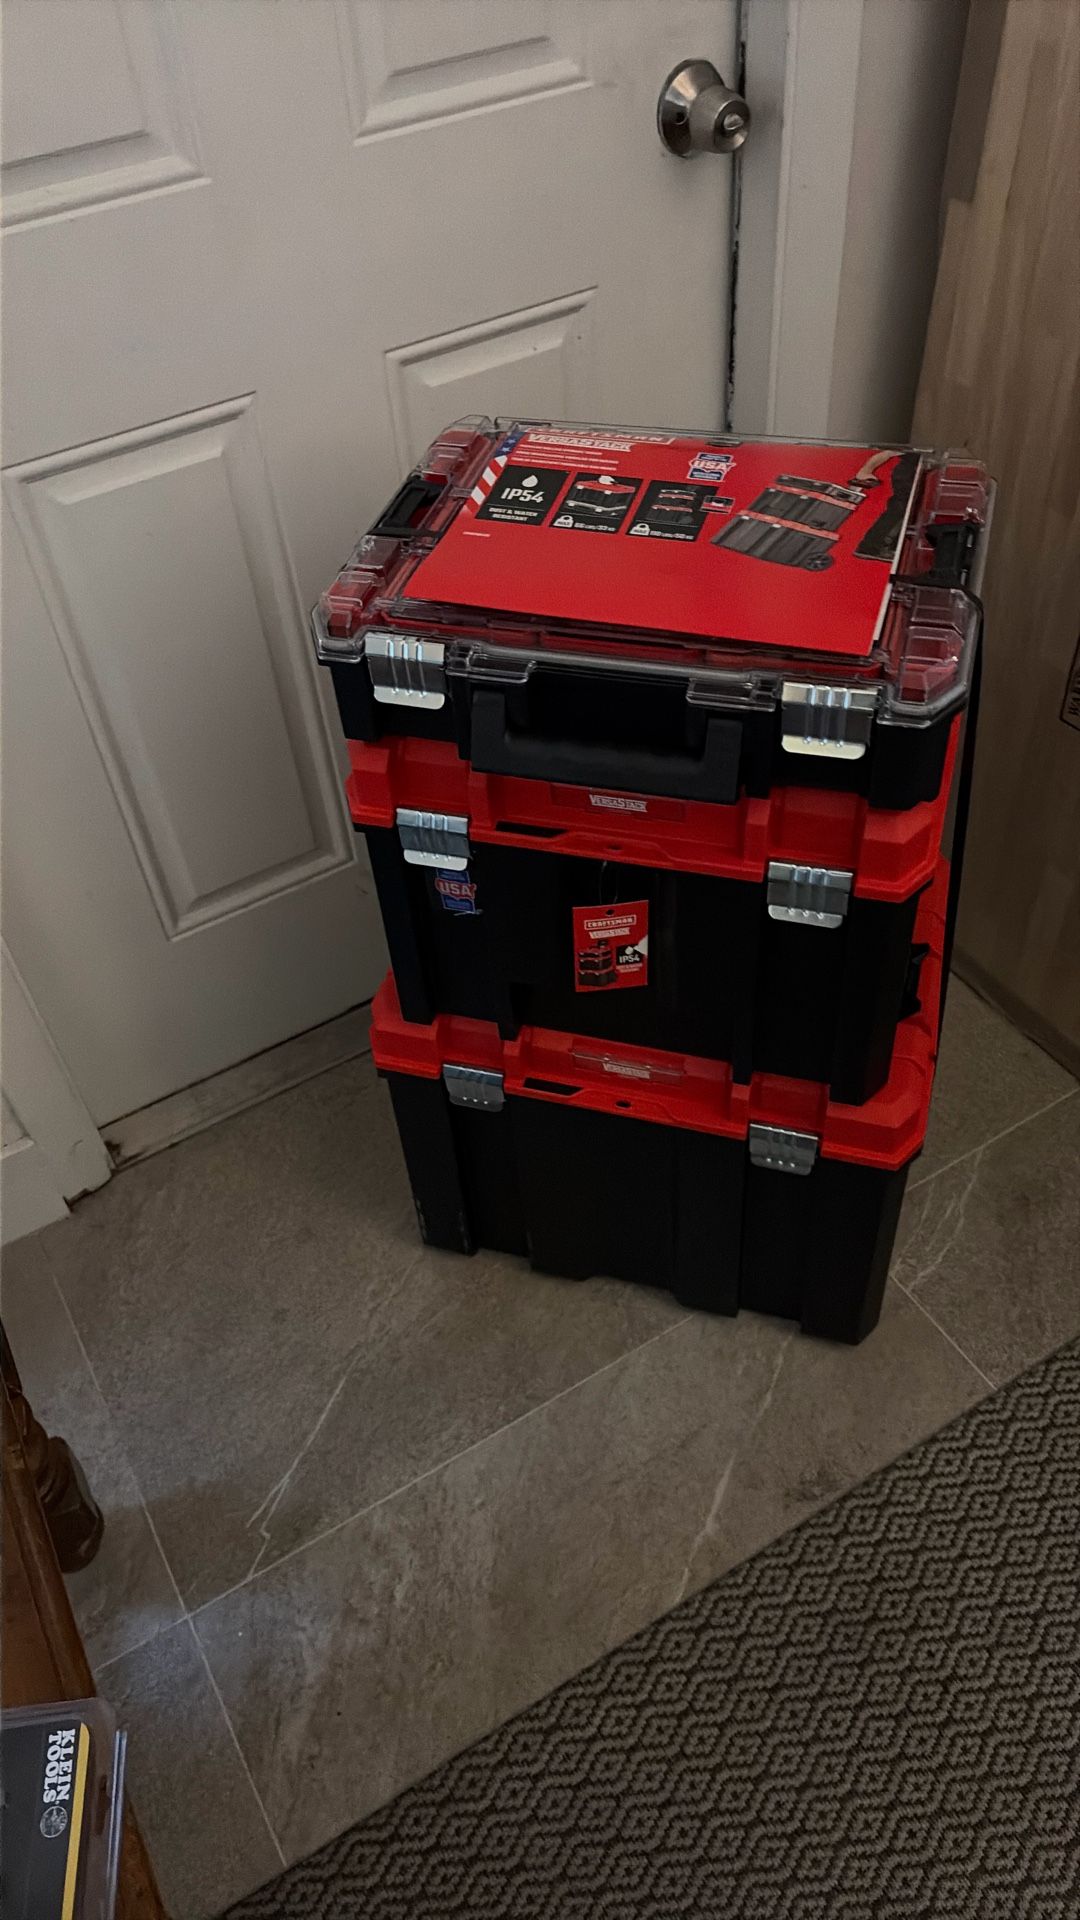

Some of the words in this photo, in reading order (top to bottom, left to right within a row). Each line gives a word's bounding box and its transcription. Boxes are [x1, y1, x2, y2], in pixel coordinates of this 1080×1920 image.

[528, 434, 634, 452] VERSASTACK
[693, 460, 728, 471] USA
[501, 488, 545, 503] IP54
[589, 794, 647, 812] VERSASTACK
[439, 881, 473, 897] USA
[587, 917, 634, 928] CRAFTSMAN
[619, 954, 640, 964] IP54
[43, 1731, 62, 1804] TOOLS
[57, 1728, 76, 1801] KLEIN
